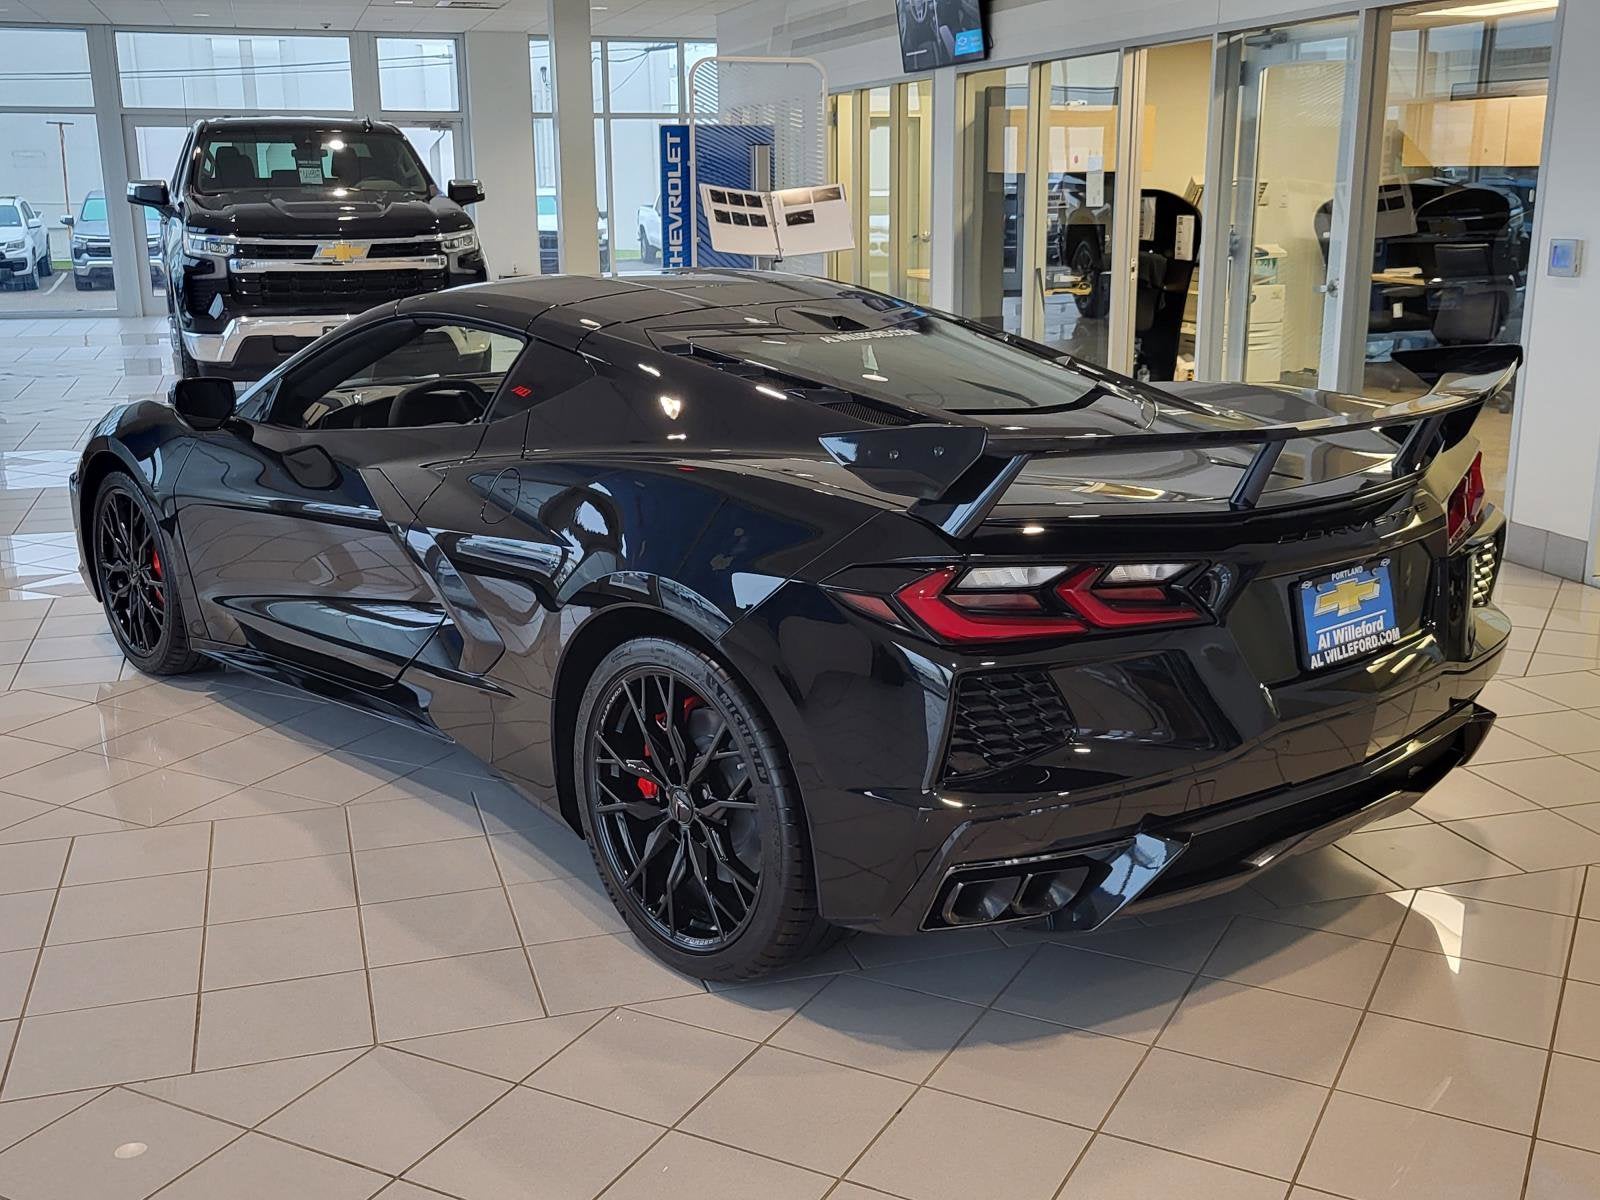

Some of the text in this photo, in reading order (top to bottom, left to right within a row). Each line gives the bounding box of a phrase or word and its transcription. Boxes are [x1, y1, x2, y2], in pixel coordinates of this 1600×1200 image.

[666, 131, 683, 268] HEVROLET
[1331, 565, 1364, 581] PORTLAND
[1311, 627, 1401, 670] AL WILLEFORD.COM
[1333, 615, 1384, 646] Willeford
[719, 691, 769, 785] MICHELIN
